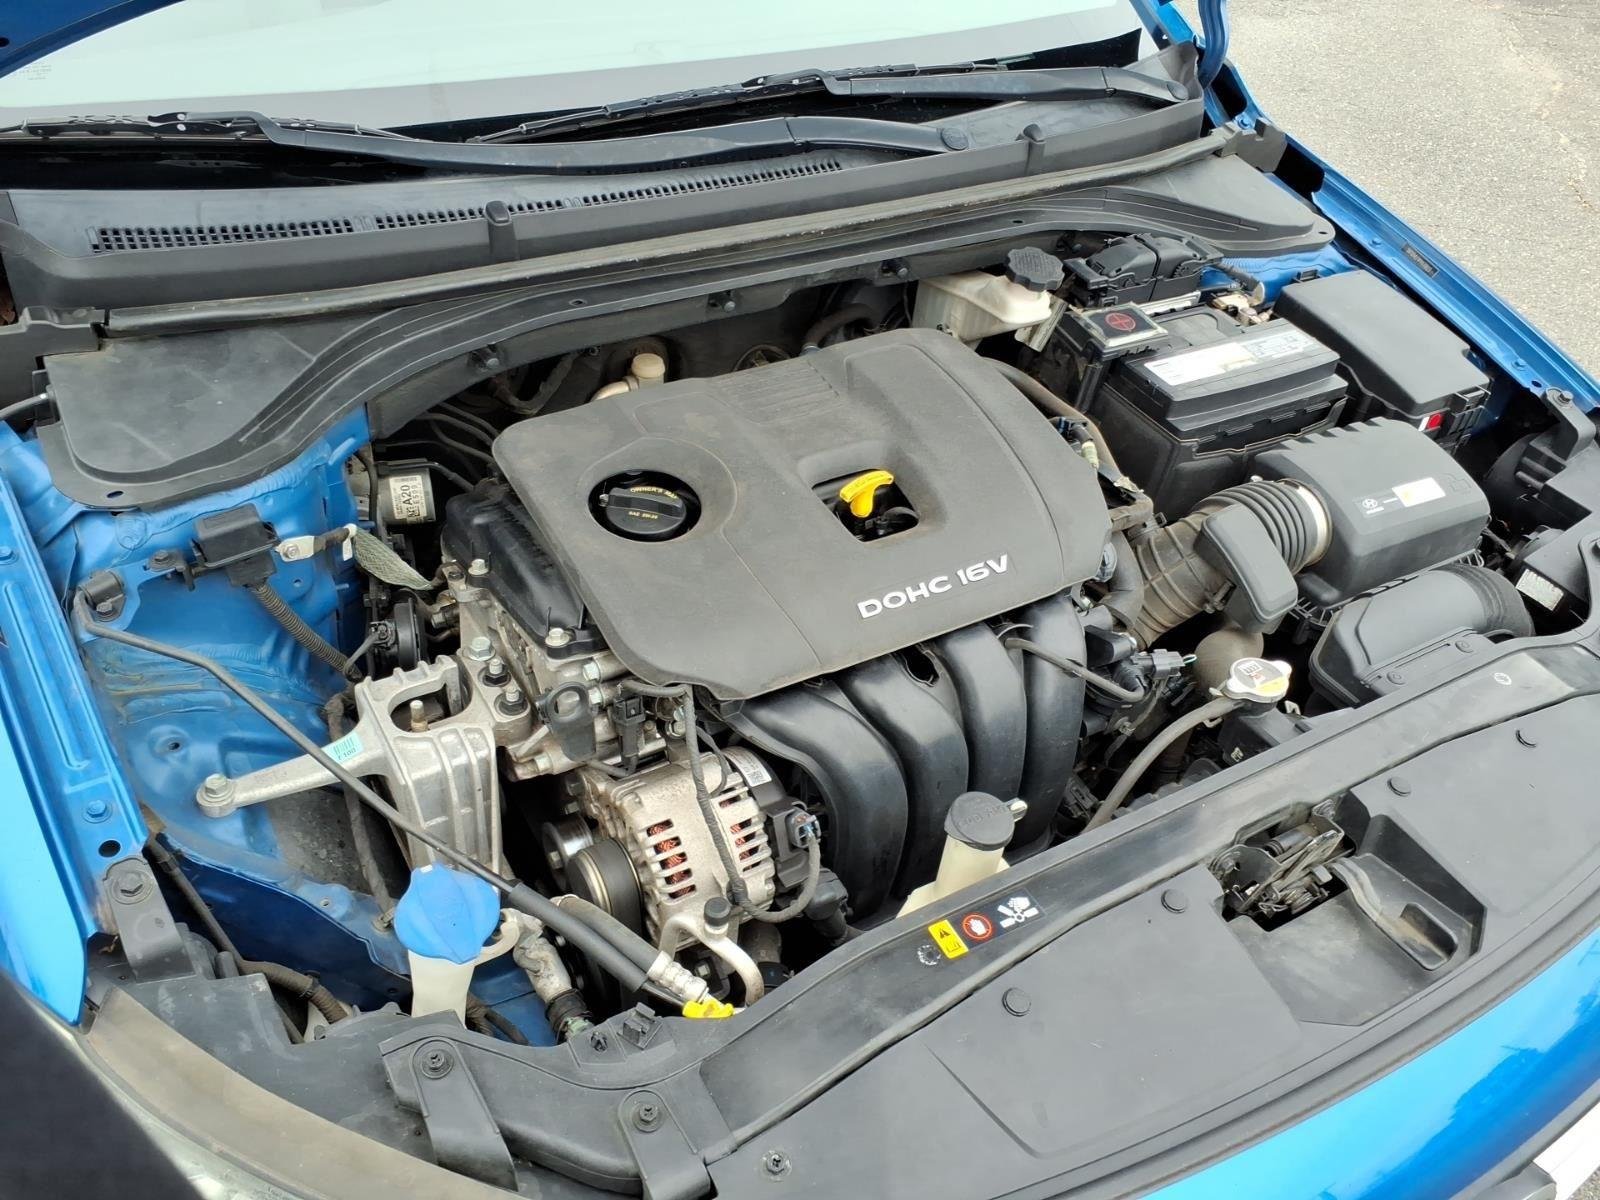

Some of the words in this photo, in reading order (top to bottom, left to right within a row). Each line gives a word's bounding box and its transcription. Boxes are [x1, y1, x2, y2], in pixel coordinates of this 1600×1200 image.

[400, 484, 412, 505] A20
[857, 575, 952, 619] DOHC
[956, 553, 1008, 585] 16V
